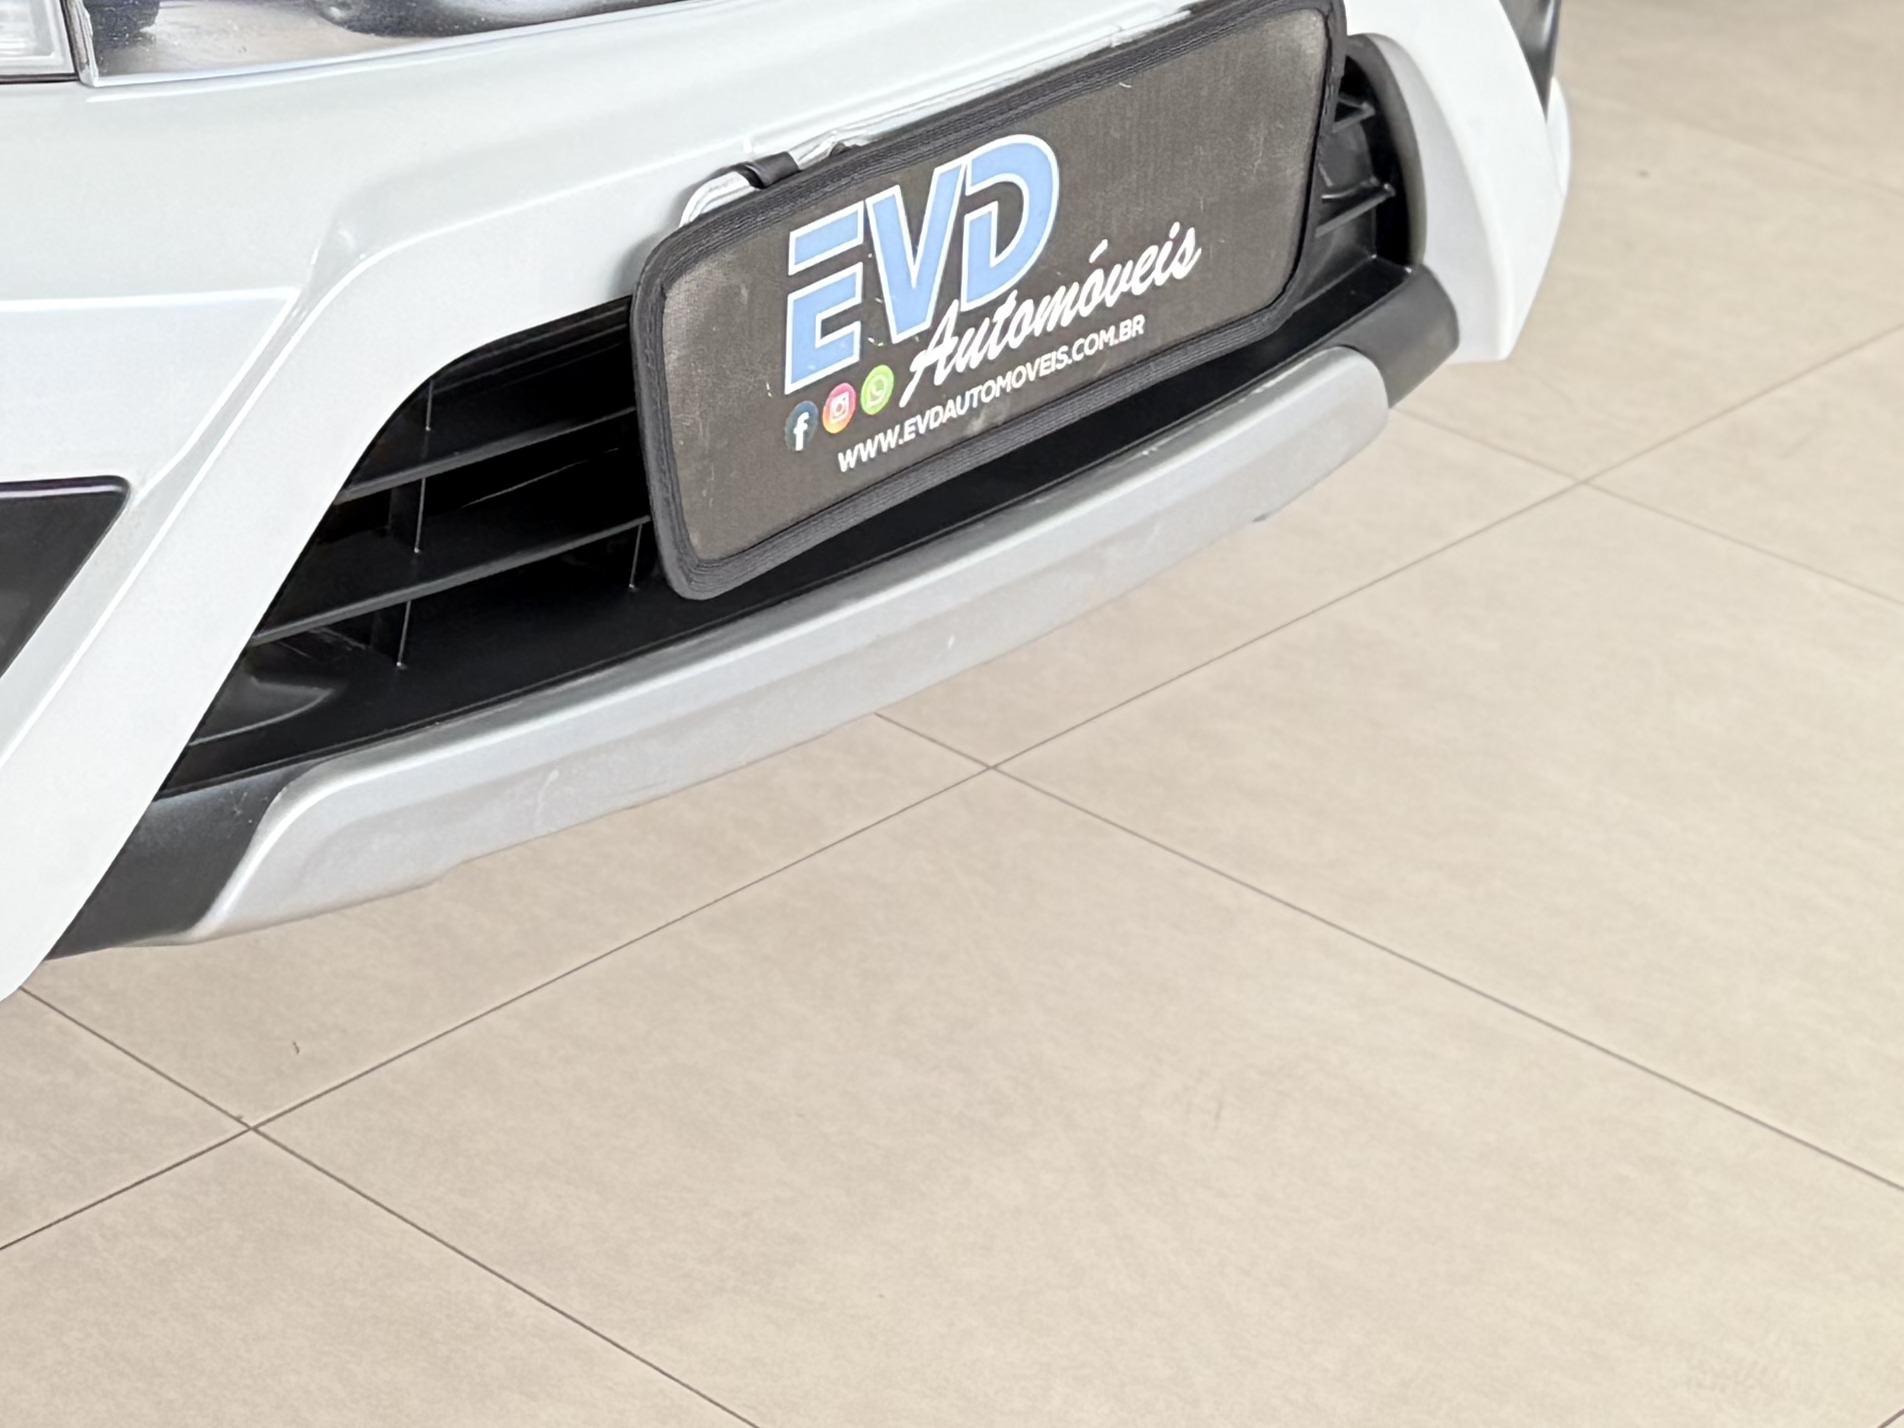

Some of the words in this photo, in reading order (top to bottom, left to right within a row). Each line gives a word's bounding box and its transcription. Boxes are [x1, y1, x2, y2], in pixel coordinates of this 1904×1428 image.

[783, 132, 1060, 396] EVD
[898, 221, 1202, 407] Automóveis
[837, 317, 1147, 474] WWW.EVDAUTOMOVEIS.COM.BR
